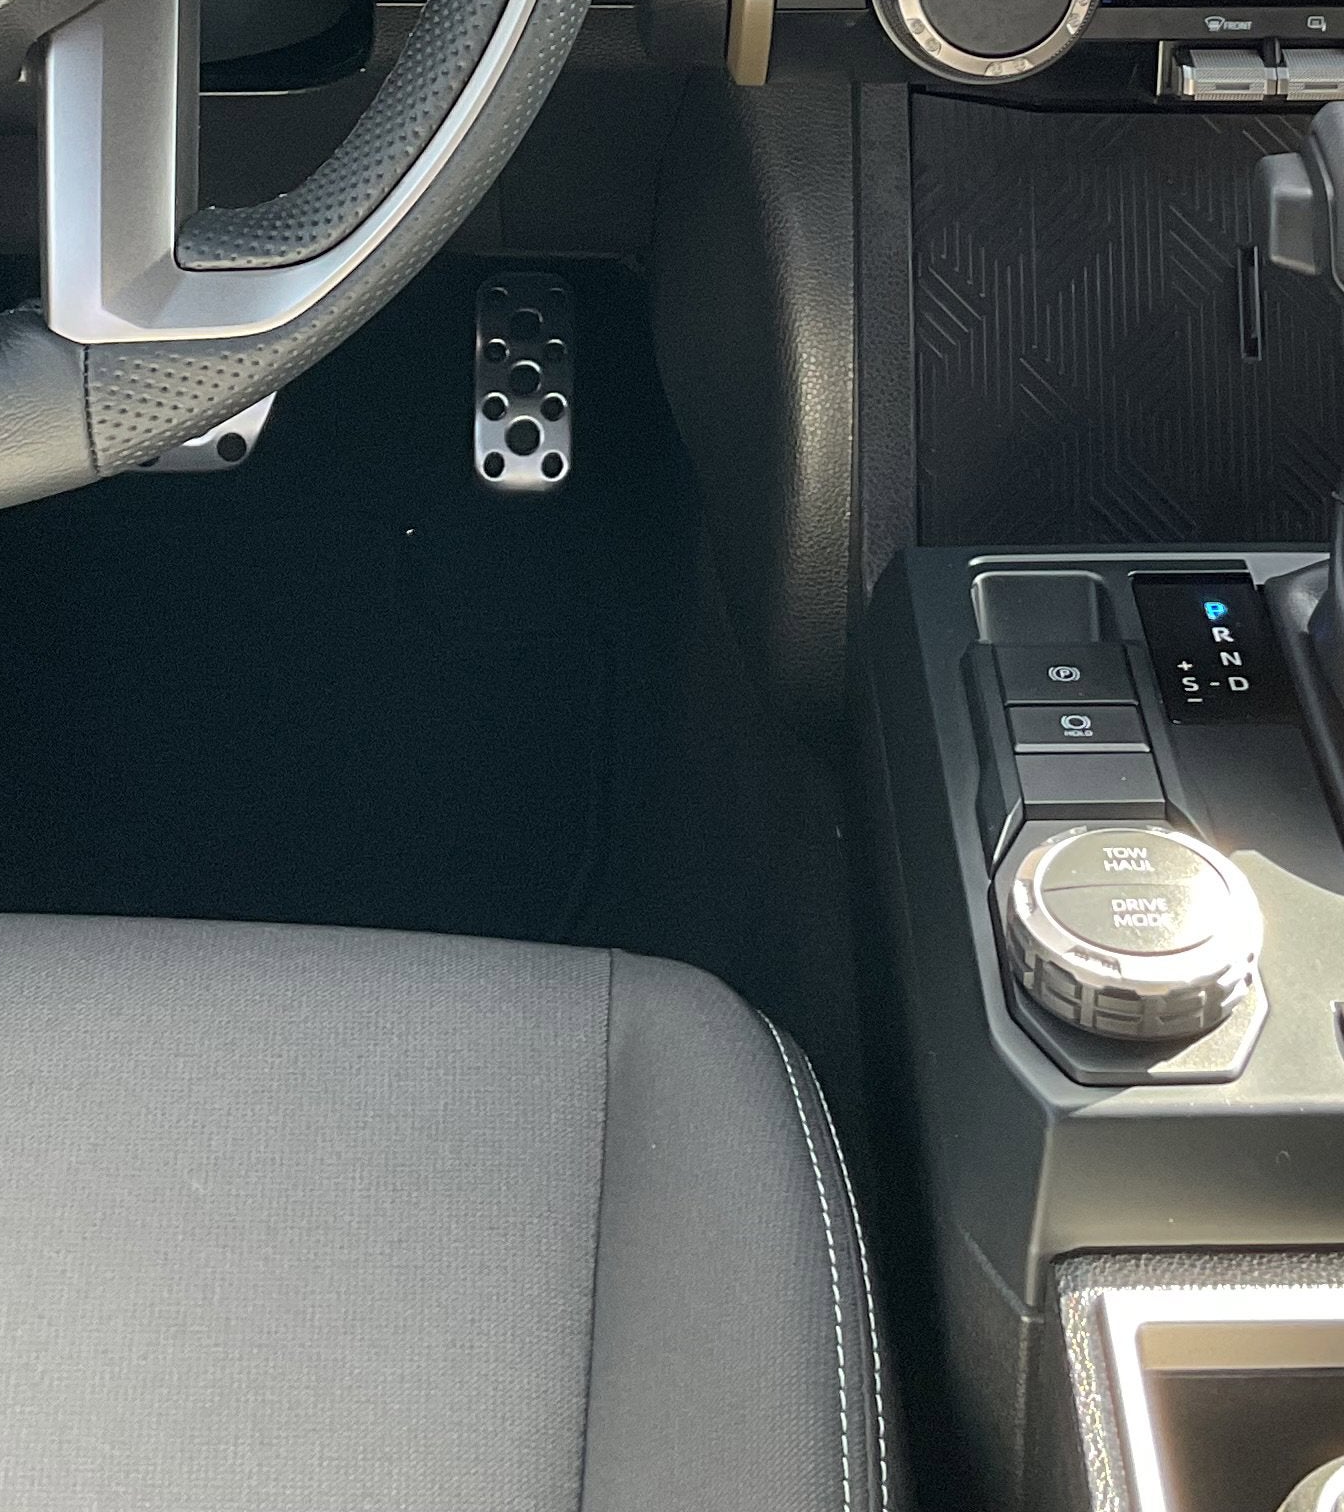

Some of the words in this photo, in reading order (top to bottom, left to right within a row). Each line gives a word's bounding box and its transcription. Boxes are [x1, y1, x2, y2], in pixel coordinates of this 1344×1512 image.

[1223, 20, 1253, 31] FRONT
[1205, 602, 1228, 620] P
[1212, 627, 1234, 642] R
[1220, 651, 1243, 667] N
[1182, 677, 1199, 692] S
[1228, 677, 1249, 691] D
[1064, 729, 1093, 737] HOLD
[1103, 847, 1147, 859] TOW
[1103, 860, 1155, 872] HAUL
[1111, 899, 1168, 912] DRIVE
[1114, 914, 1174, 928] MODE
